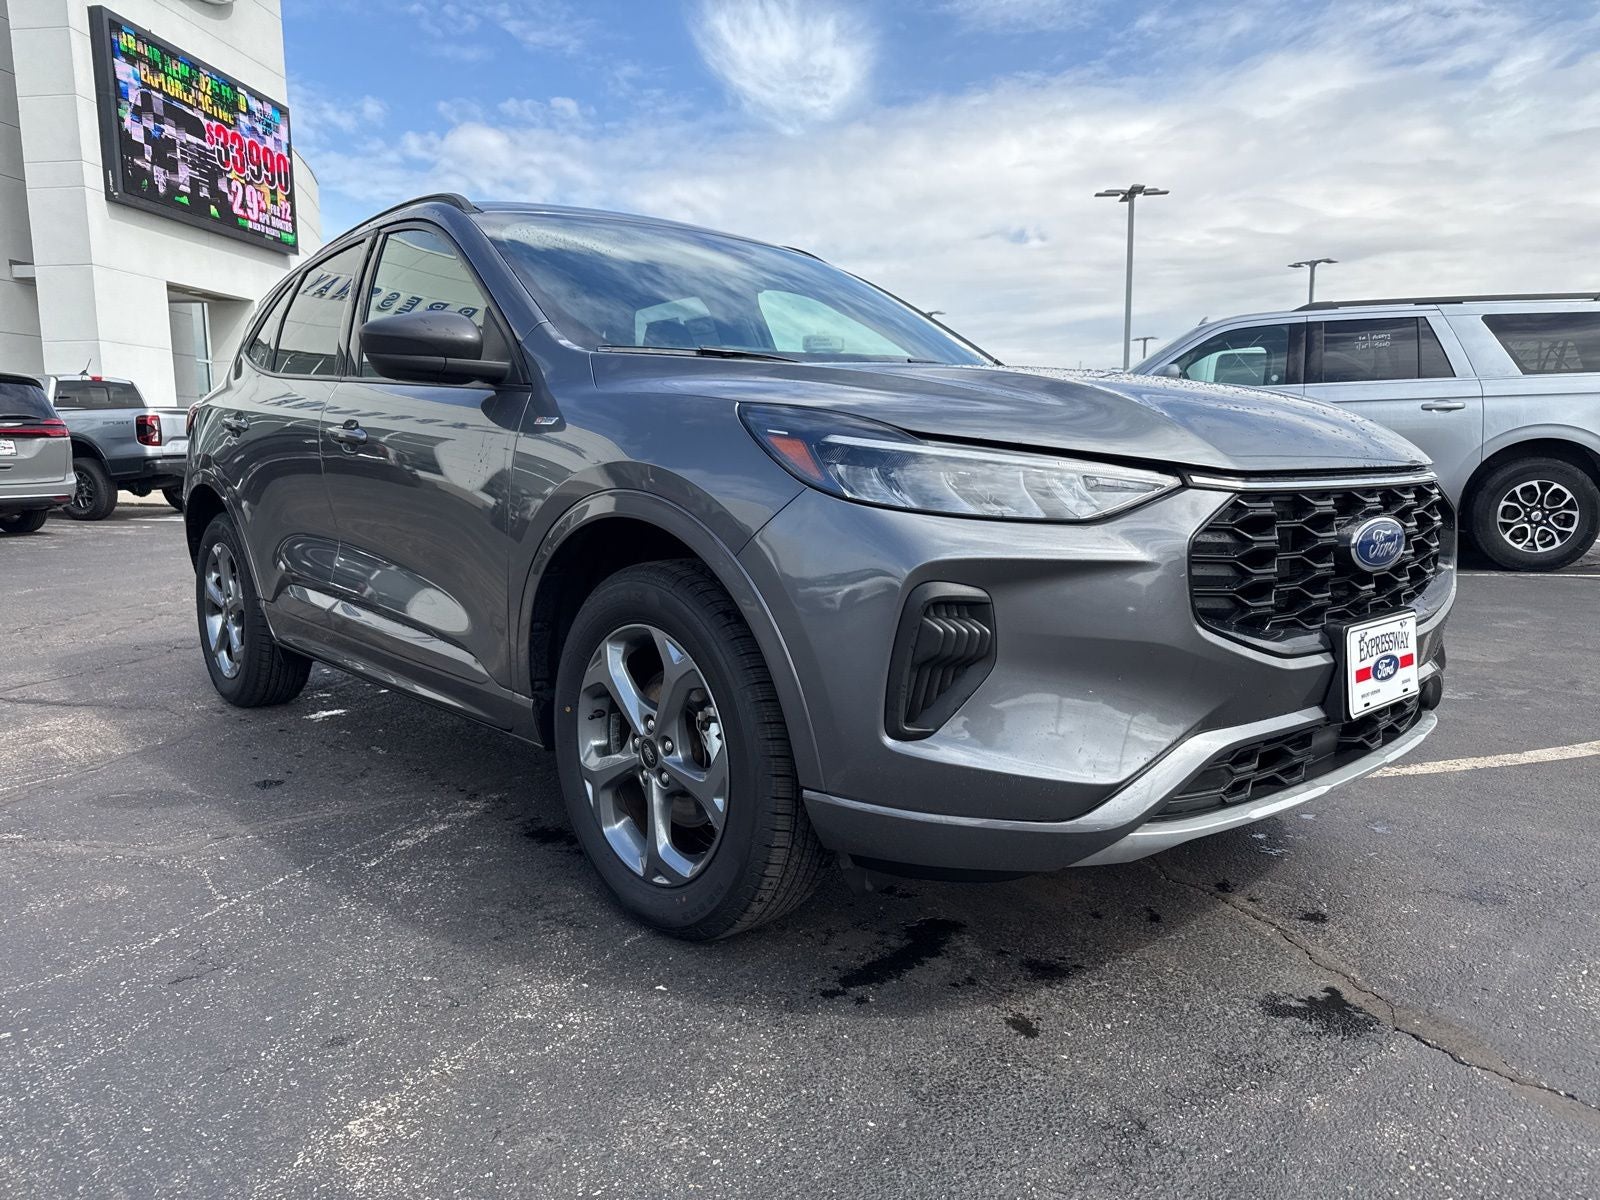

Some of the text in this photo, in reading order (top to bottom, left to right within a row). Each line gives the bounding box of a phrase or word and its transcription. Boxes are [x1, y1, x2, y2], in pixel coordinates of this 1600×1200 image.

[1369, 529, 1399, 559] Ford
[1358, 631, 1410, 663] EXPRESSWAY
[1377, 657, 1396, 680] Ford
